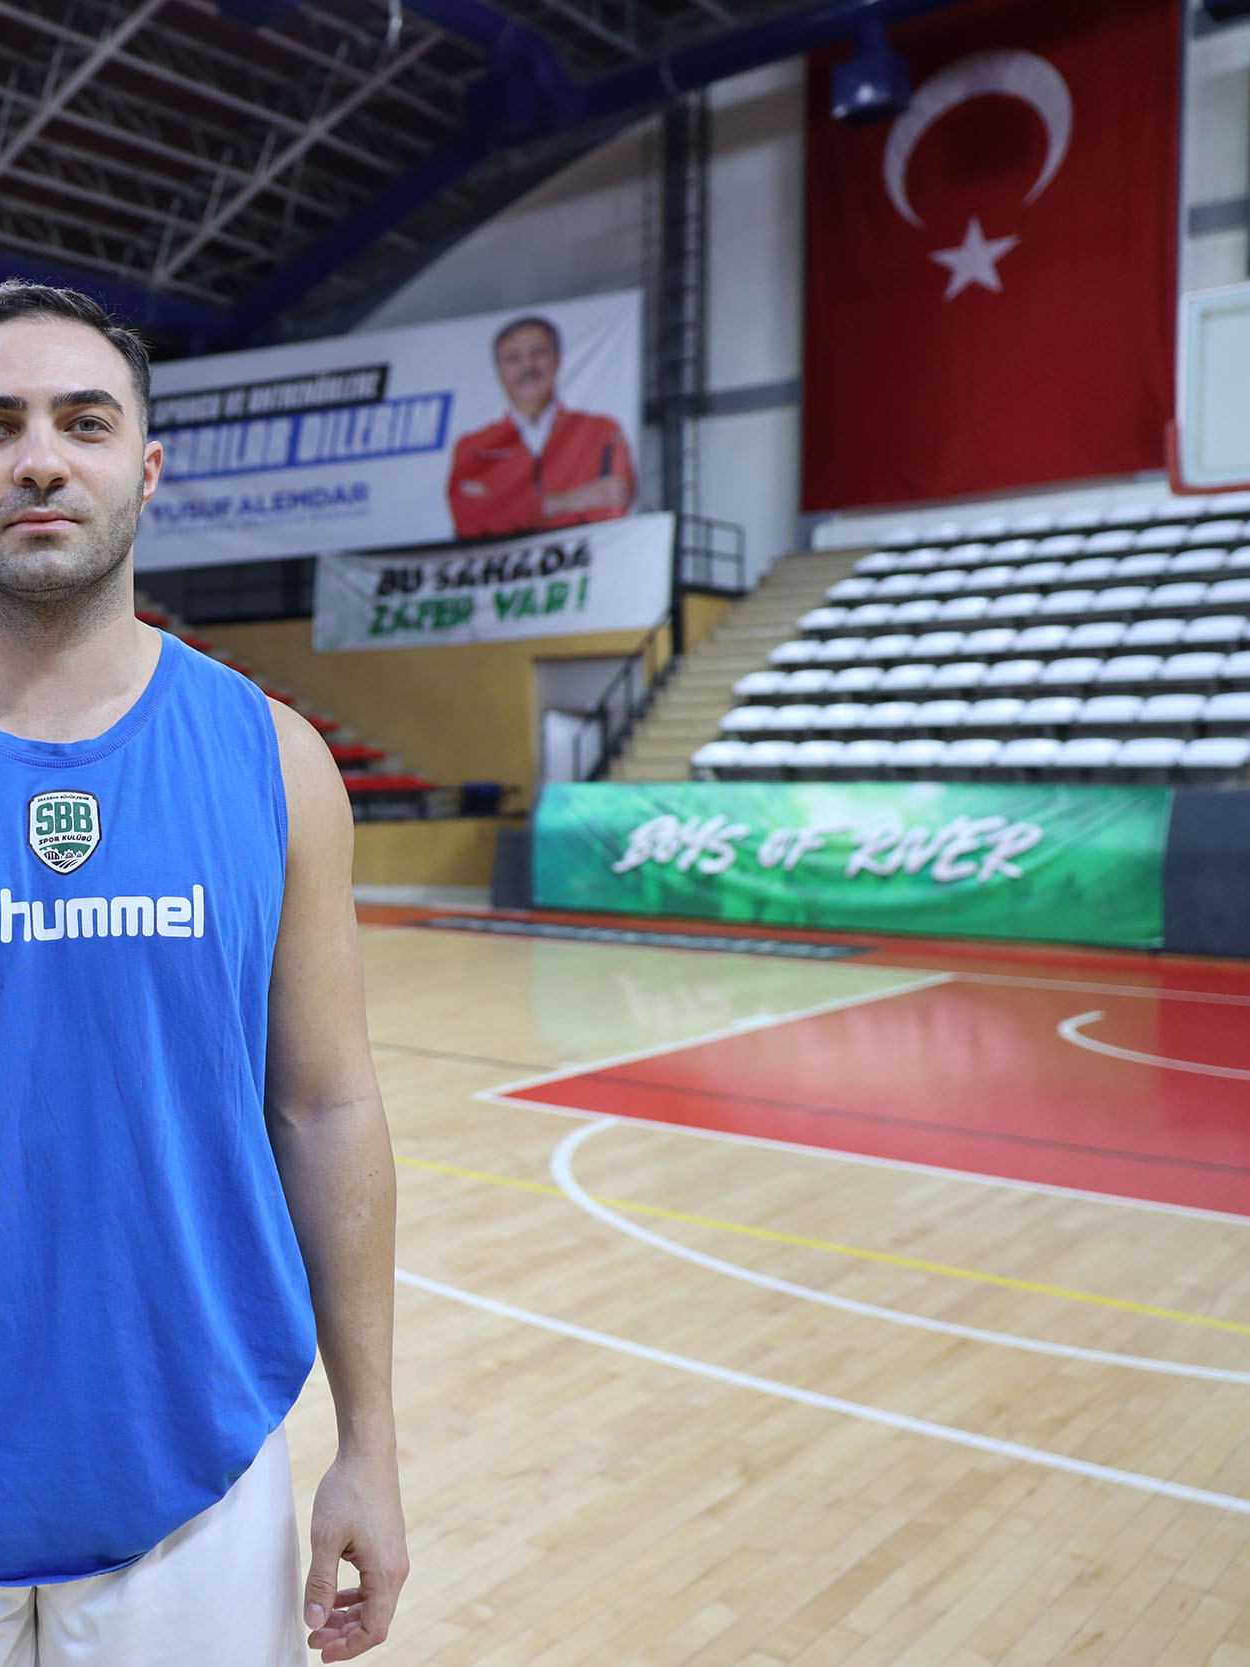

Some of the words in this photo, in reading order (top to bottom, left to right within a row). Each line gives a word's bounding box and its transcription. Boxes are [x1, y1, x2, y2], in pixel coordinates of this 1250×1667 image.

[238, 482, 370, 517] ALEMDAR
[36, 801, 93, 836] SBB
[38, 835, 60, 846] SPOR
[62, 833, 93, 842] KULÜBÜ
[612, 813, 749, 875] BOYS
[757, 823, 852, 871] OF
[845, 815, 1043, 883] RIVER
[0, 883, 205, 943] hummel
